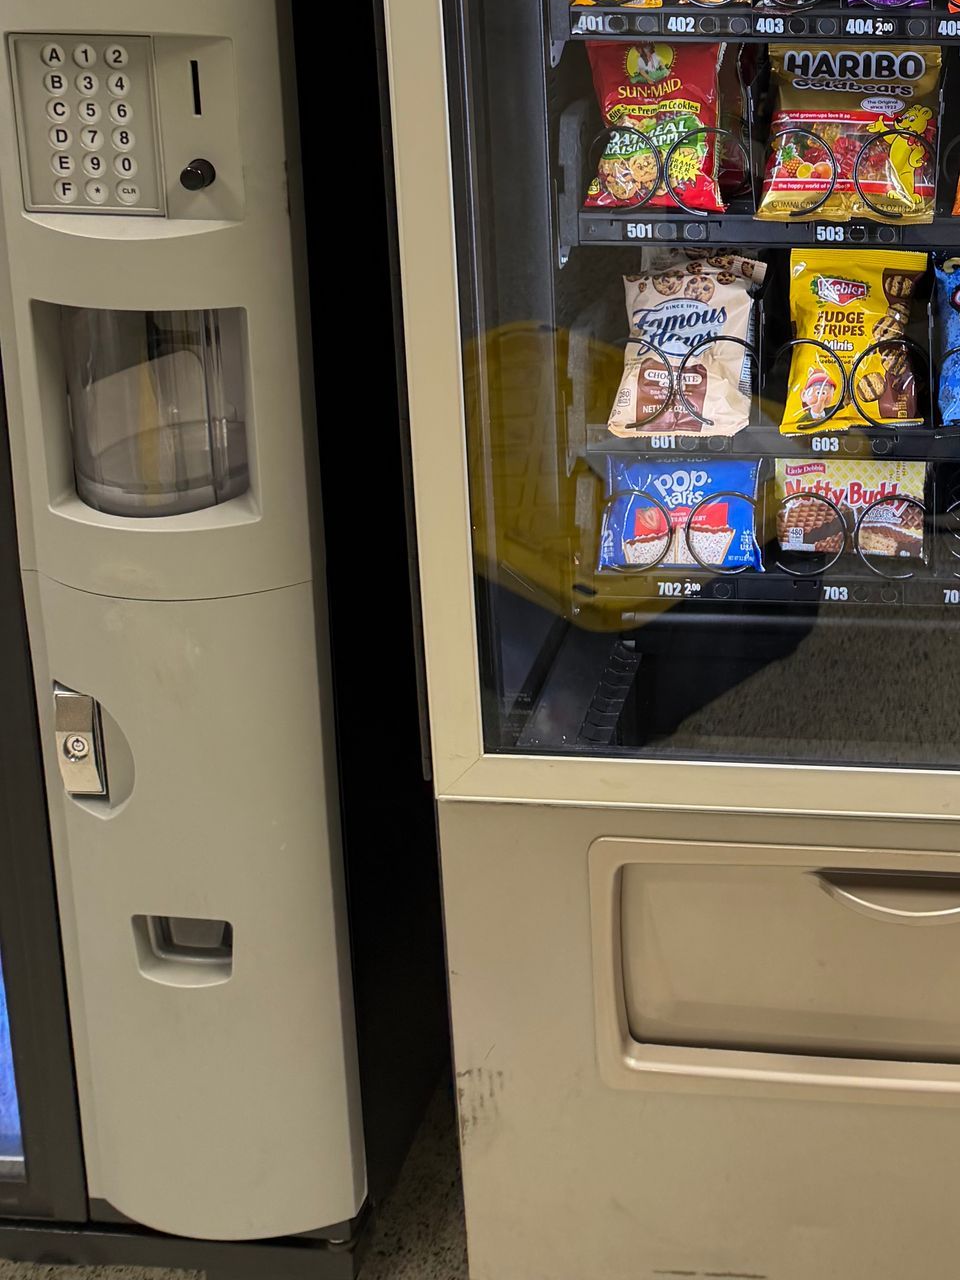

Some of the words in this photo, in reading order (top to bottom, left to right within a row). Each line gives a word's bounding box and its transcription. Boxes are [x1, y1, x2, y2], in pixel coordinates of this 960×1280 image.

[578, 16, 603, 30] 401
[667, 17, 695, 32] 402
[756, 18, 783, 33] 403
[846, 19, 873, 34] 404
[49, 48, 61, 62] A
[82, 49, 88, 62] 1
[112, 50, 122, 63] 2
[785, 52, 925, 80] HARIBO
[51, 75, 62, 89] B
[84, 76, 93, 90] 3
[115, 77, 124, 90] 4
[793, 79, 914, 96] Goldbears
[54, 102, 65, 116] C
[86, 104, 95, 117] 5
[117, 104, 127, 118] 6
[56, 129, 68, 143] D
[88, 130, 98, 143] 7
[120, 131, 129, 144] 8
[59, 156, 70, 169] E
[91, 157, 100, 170] 9
[122, 158, 131, 171] 0
[62, 183, 72, 195] F
[627, 223, 653, 238] 501
[817, 226, 844, 240] 503
[632, 305, 727, 335] Famous
[817, 311, 865, 324] FUDGE
[814, 325, 865, 337] STRIPES
[824, 340, 853, 351] Minis
[651, 436, 676, 448] 601
[812, 438, 839, 451] 603
[664, 490, 704, 508] tarts
[785, 480, 845, 507] Nutty
[849, 482, 905, 514] Buddy
[658, 583, 681, 596] 702
[824, 587, 848, 600] 703
